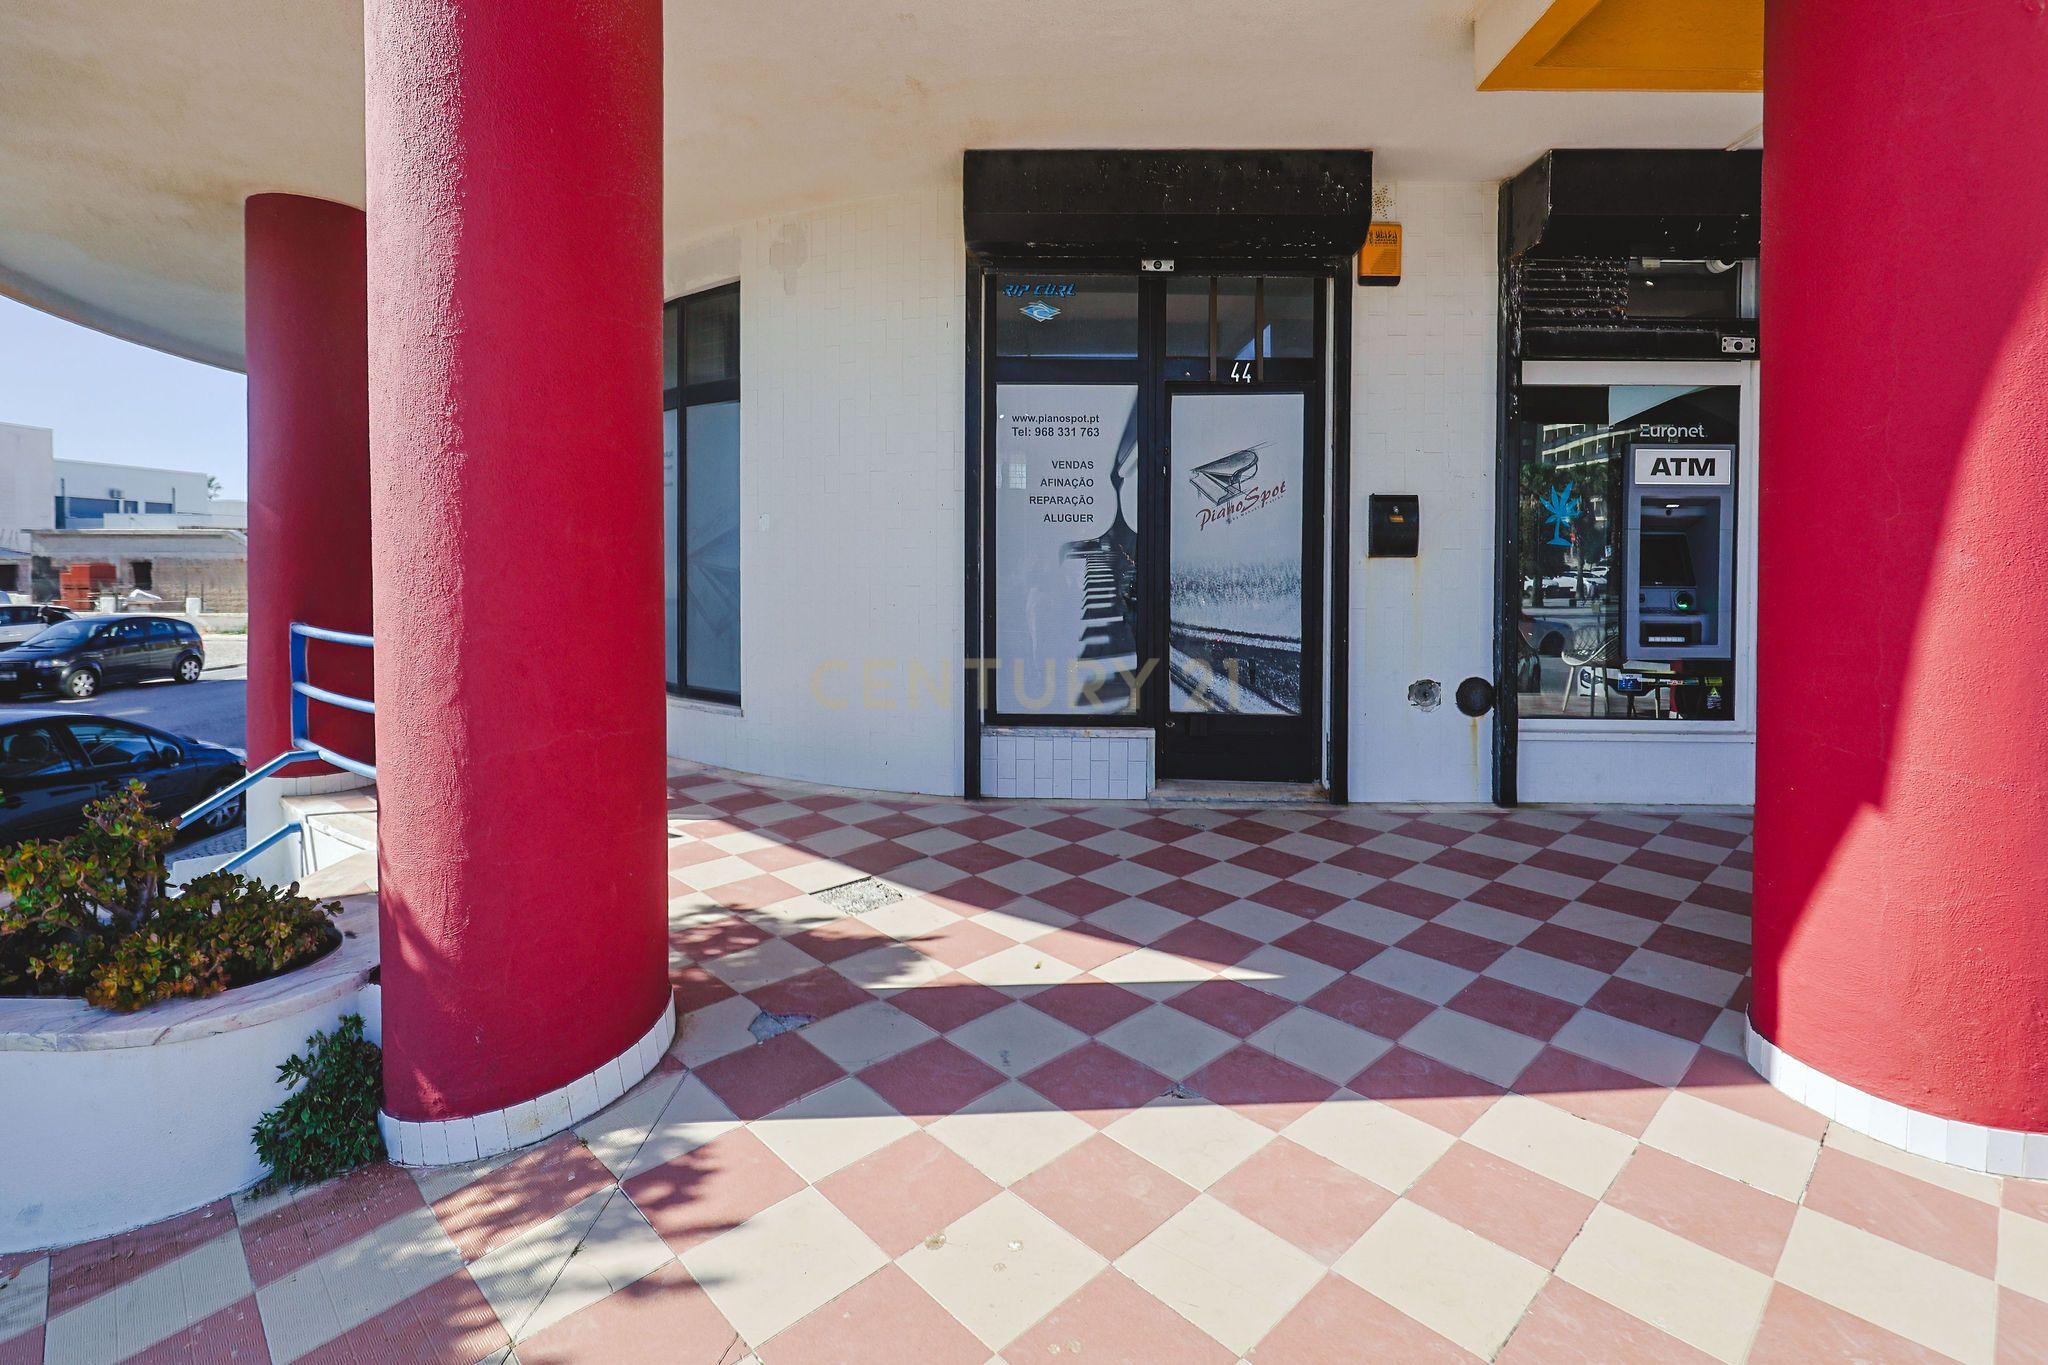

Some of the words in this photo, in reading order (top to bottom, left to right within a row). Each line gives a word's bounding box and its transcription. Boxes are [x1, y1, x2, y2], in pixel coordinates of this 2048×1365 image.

[1002, 283, 1031, 297] RIP
[1033, 283, 1077, 297] CURL
[1230, 361, 1252, 384] 44
[1011, 414, 1100, 424] www.pianospot.pt
[1011, 427, 1031, 437] Tel:
[1034, 427, 1054, 437] 968
[1057, 427, 1077, 437] 331
[1080, 427, 1100, 437] 763
[1639, 423, 1705, 438] Euronet
[1051, 460, 1094, 470] VENDAS
[1650, 457, 1715, 476] ATM
[1040, 476, 1094, 489] AFINAÇÃO
[1029, 494, 1094, 506] REPARAÇÃO
[1043, 514, 1094, 523] ALUGUER
